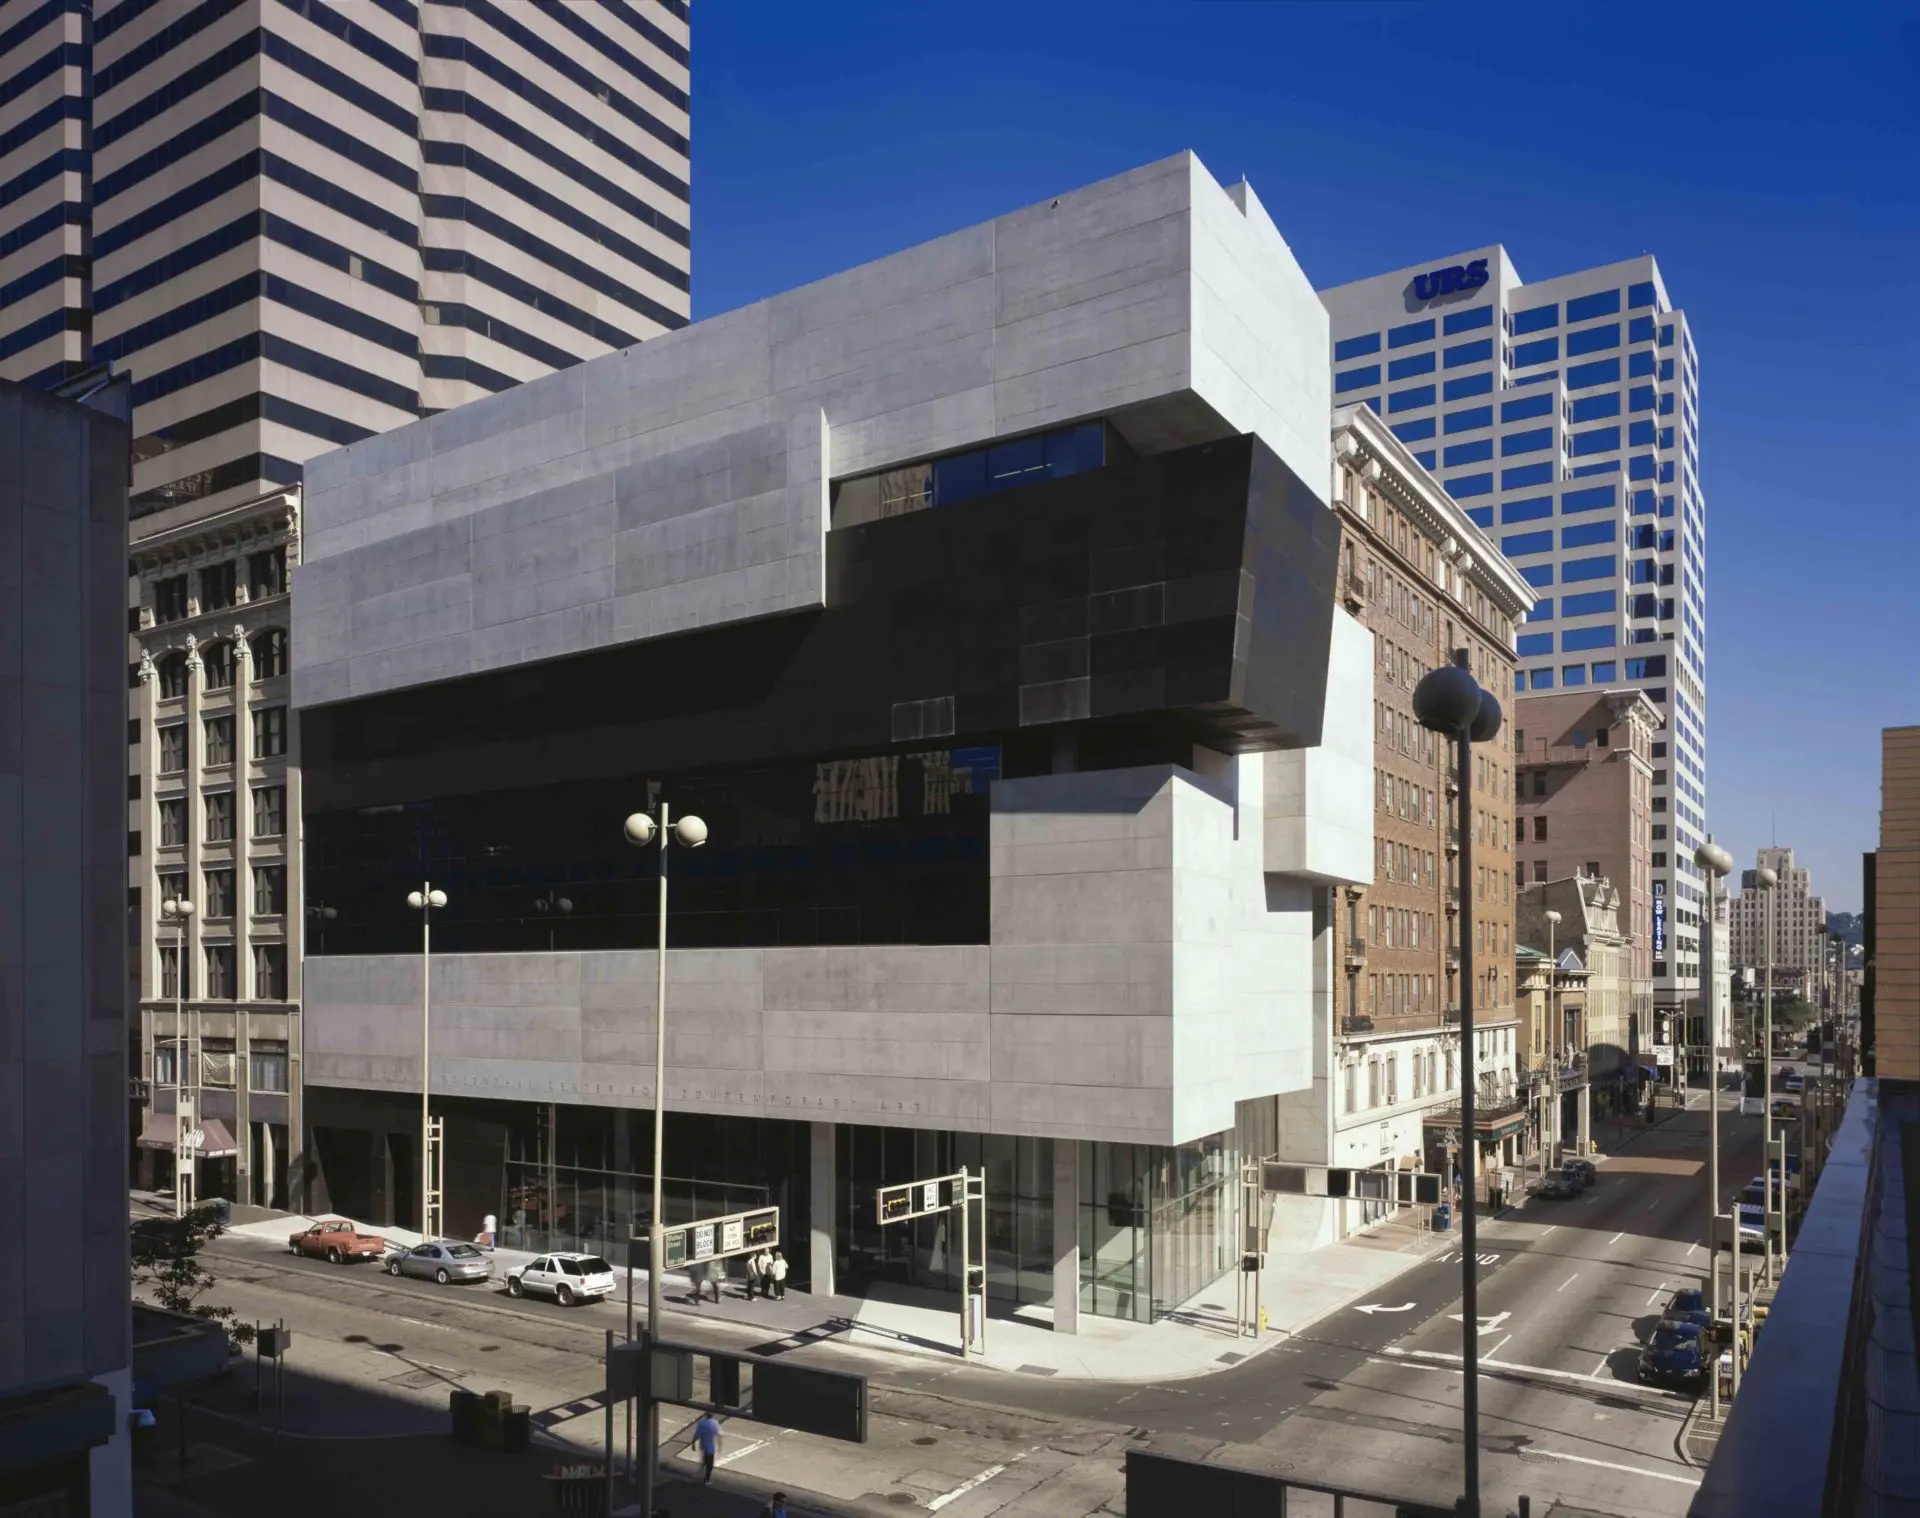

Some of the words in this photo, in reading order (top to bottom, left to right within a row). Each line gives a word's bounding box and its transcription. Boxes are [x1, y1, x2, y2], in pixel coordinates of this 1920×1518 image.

[1413, 258, 1489, 300] URS
[1655, 900, 1663, 915] NOW
[880, 1101, 921, 1113] ART
